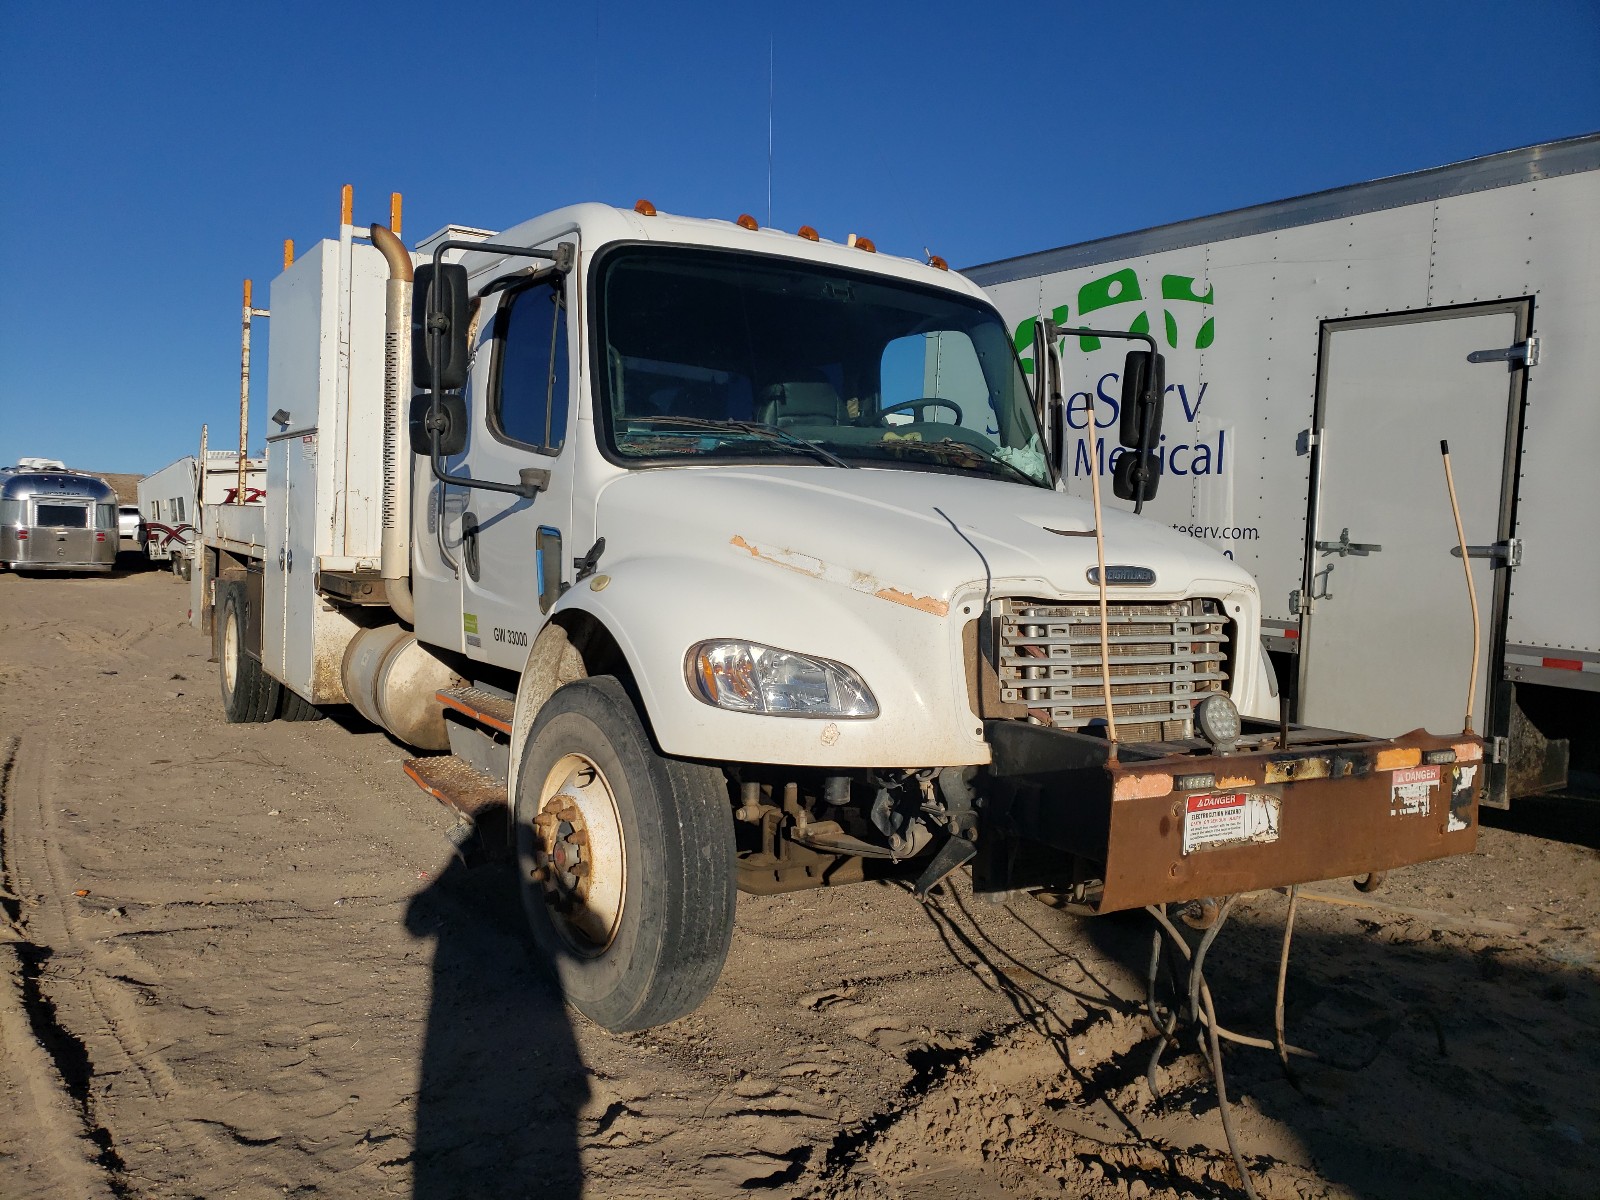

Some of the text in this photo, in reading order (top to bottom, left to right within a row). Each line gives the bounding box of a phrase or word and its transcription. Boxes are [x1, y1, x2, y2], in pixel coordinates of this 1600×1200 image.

[1066, 372, 1209, 430] eSrv
[1074, 429, 1225, 477] Meical
[493, 627, 506, 643] GW
[507, 629, 528, 647] 33000
[1405, 769, 1436, 782] DANGER
[1203, 795, 1236, 807] DANGER
